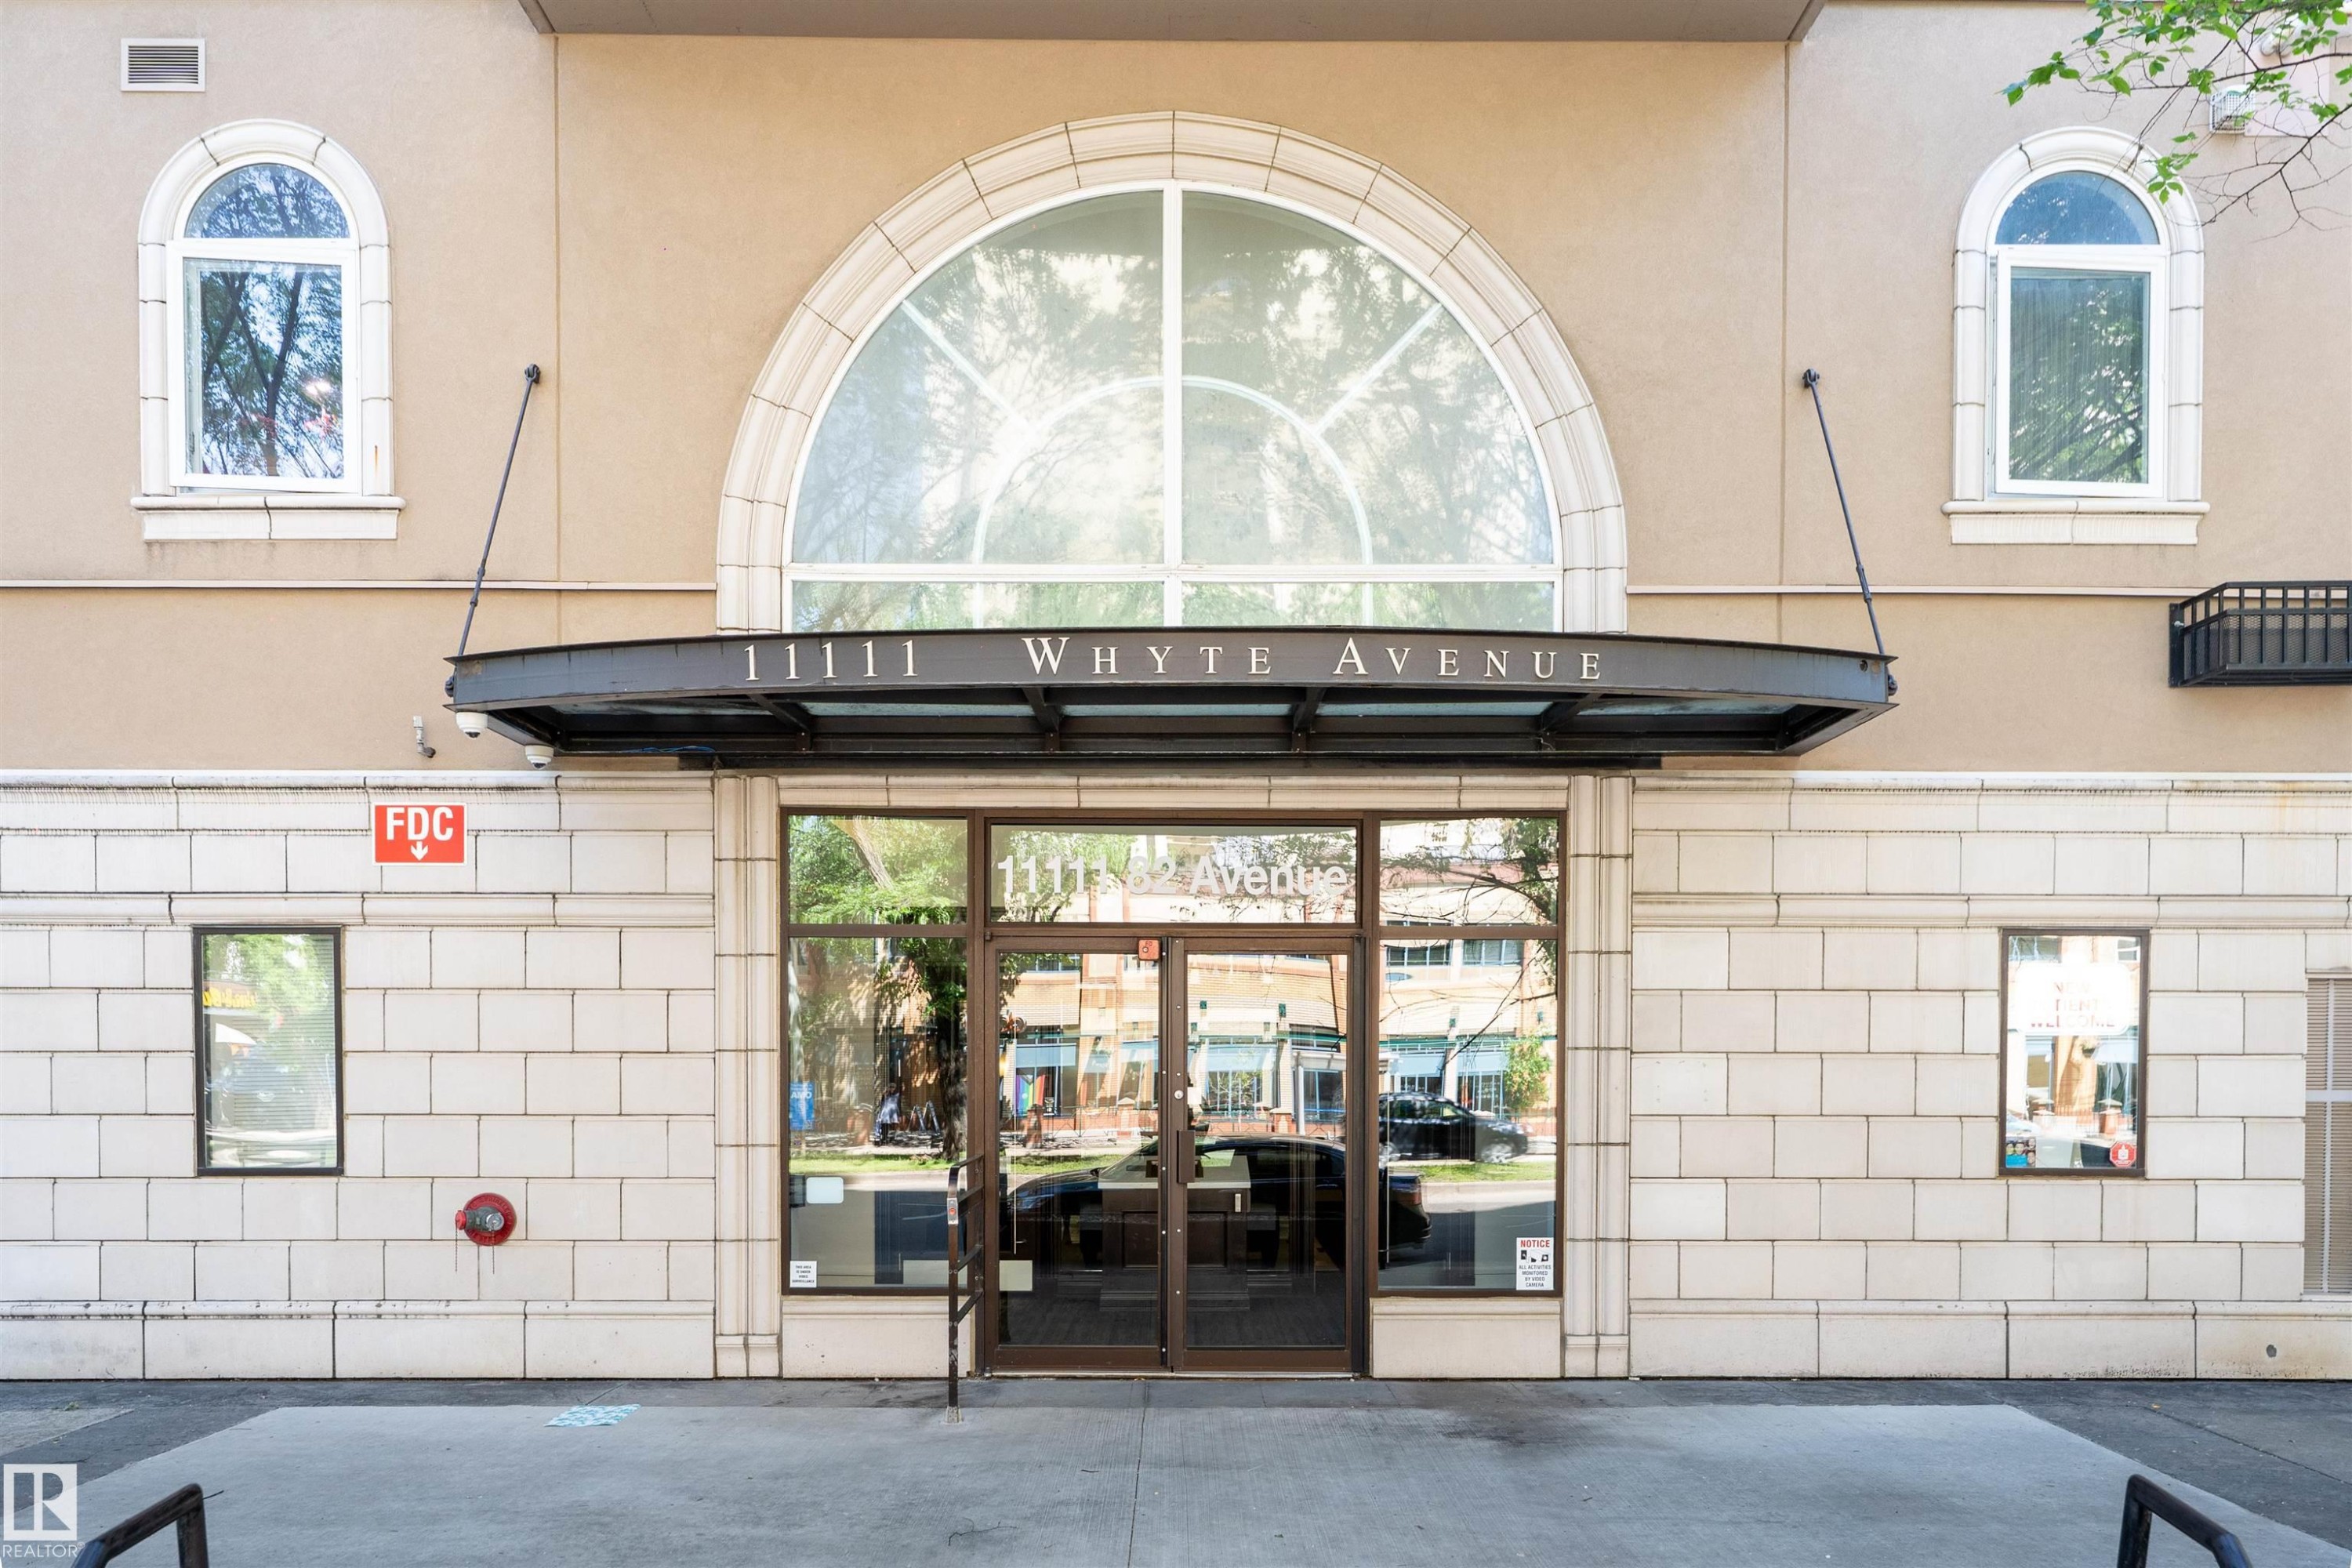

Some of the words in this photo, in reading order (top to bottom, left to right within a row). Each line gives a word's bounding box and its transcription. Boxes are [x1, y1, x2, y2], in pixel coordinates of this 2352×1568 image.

[744, 639, 919, 681] 11111
[1022, 637, 1272, 676] WHYTE
[1333, 637, 1601, 681] AVENUE
[387, 806, 454, 841] FDC
[997, 855, 1109, 895] 11111
[1127, 855, 1177, 895] 82
[1189, 855, 1348, 896] Avenue
